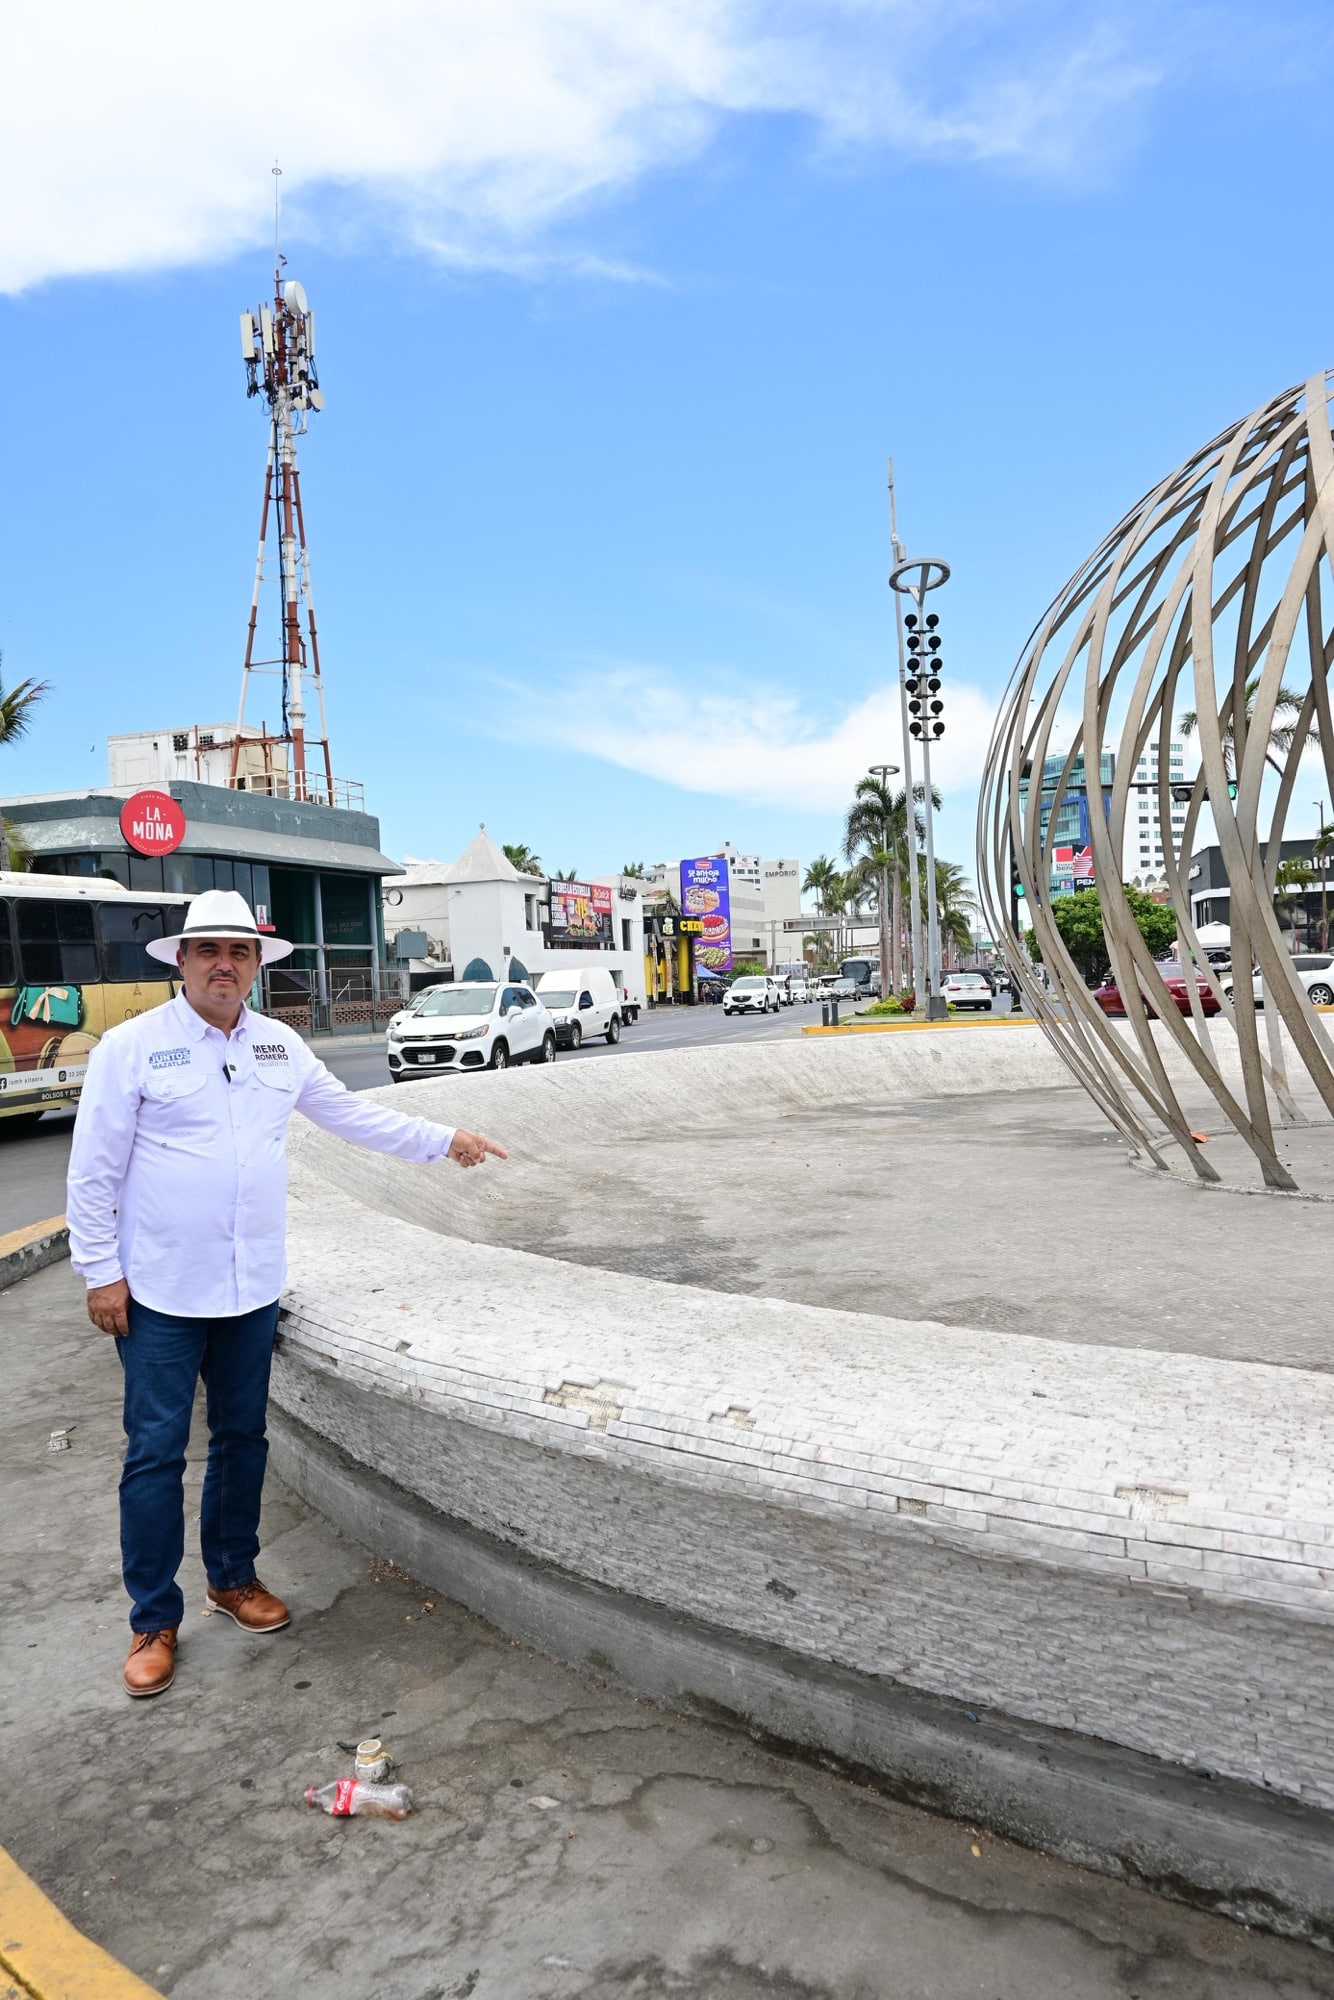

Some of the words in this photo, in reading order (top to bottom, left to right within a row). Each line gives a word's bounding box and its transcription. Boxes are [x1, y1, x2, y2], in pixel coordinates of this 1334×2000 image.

[146, 806, 161, 821] LA
[133, 821, 174, 841] MONA
[696, 869, 720, 878] antoja
[765, 870, 797, 878] EMPORIO
[252, 1044, 286, 1054] MEMO
[149, 1051, 191, 1064] JUNTOS
[255, 1053, 289, 1061] ROMERO
[42, 1091, 64, 1100] BOLSOS
